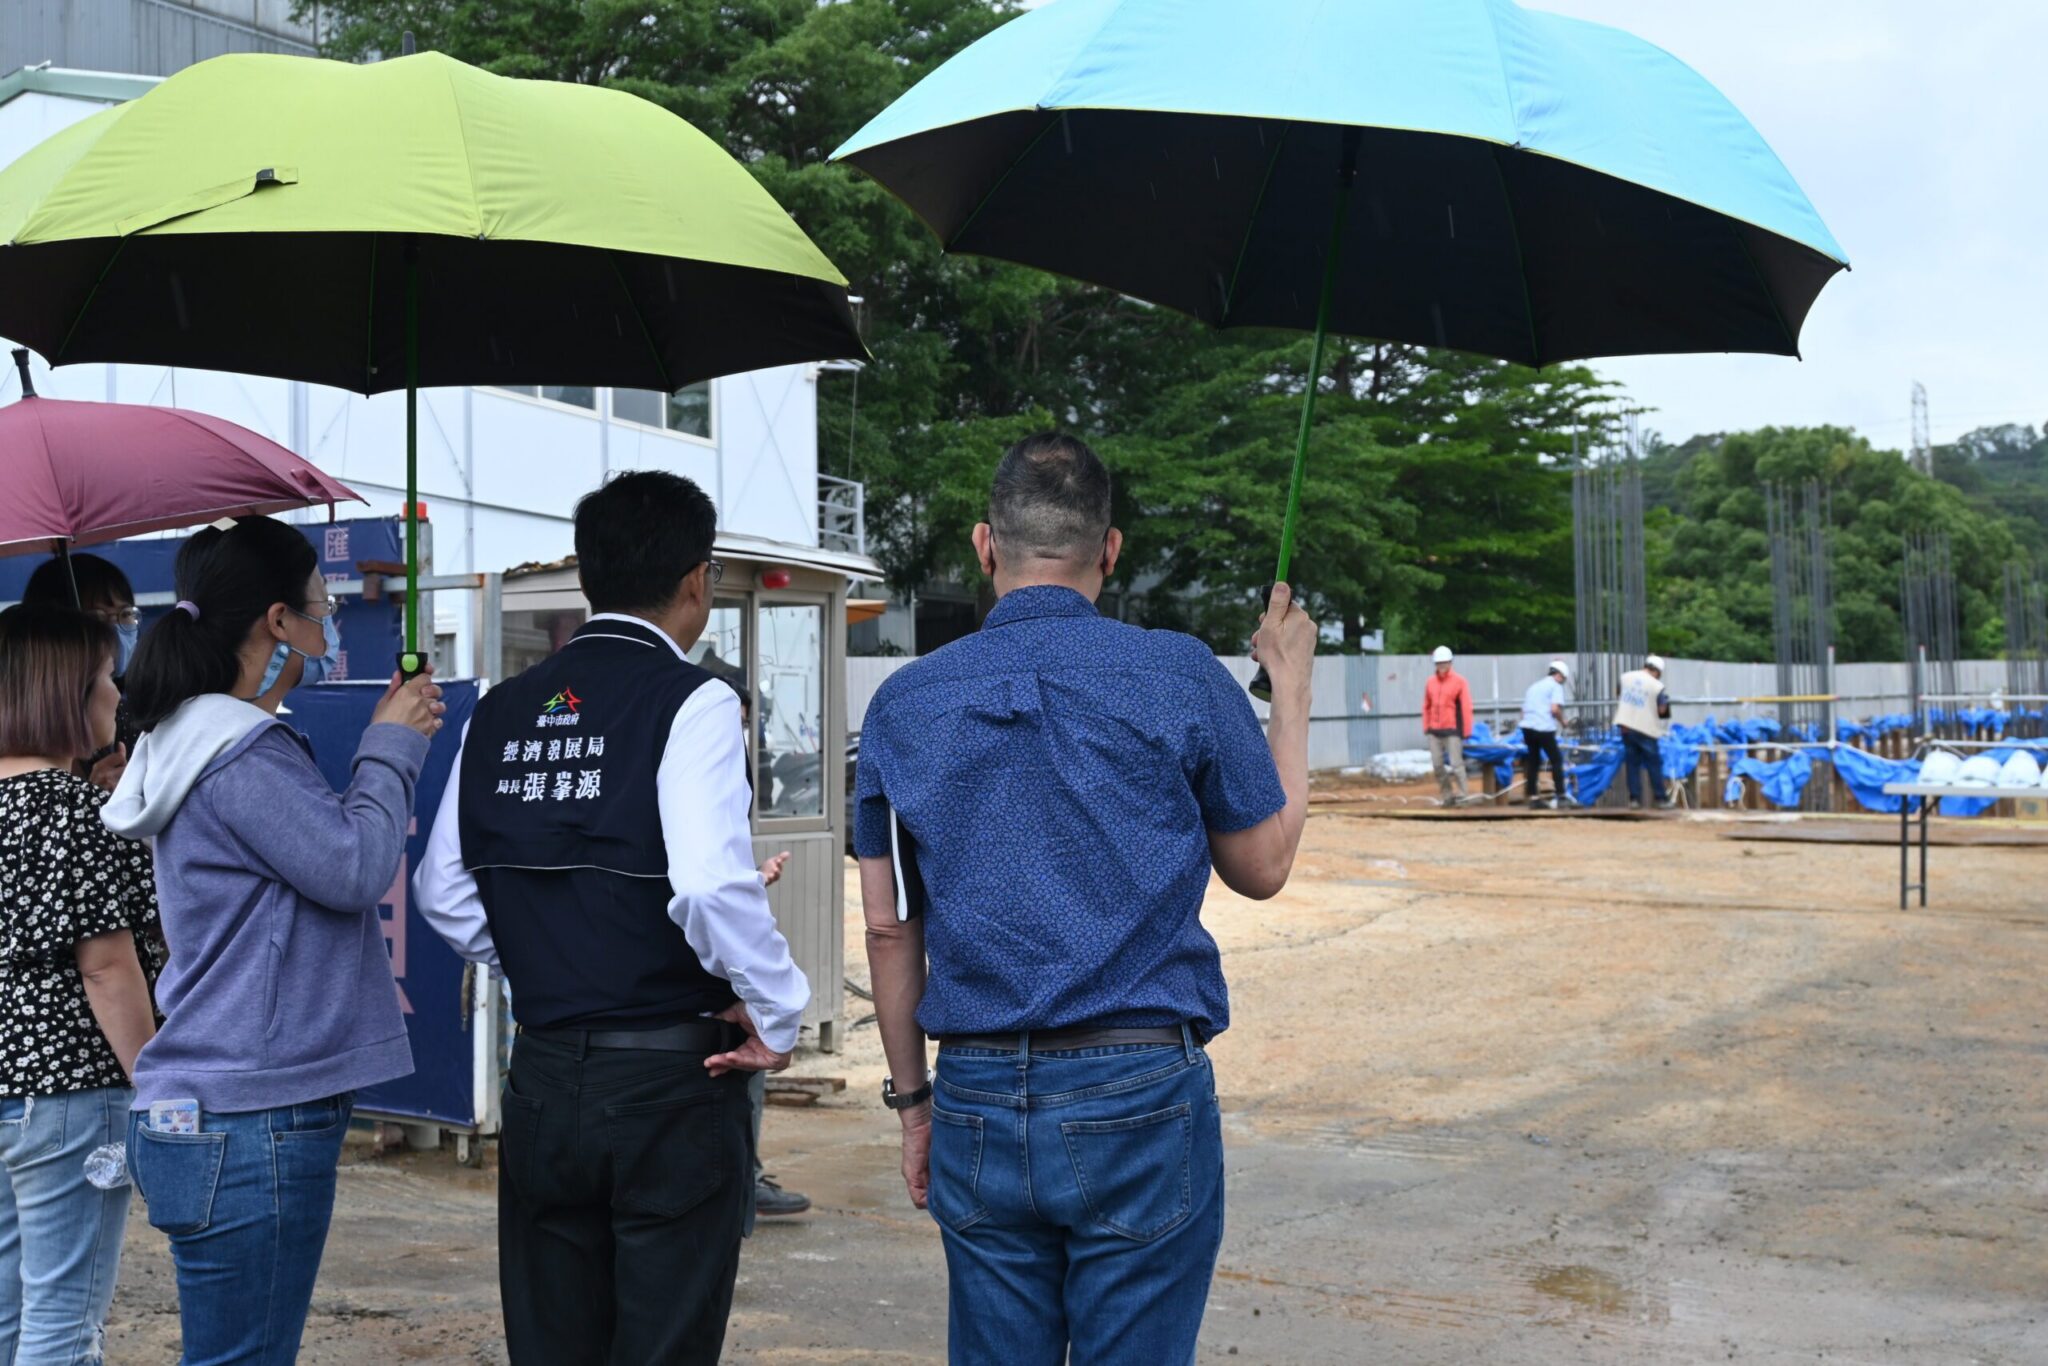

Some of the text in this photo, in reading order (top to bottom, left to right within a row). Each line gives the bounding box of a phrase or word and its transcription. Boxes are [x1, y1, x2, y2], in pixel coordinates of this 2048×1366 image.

[536, 712, 580, 728] 臺中市政府
[502, 736, 605, 763] 經濟發展局
